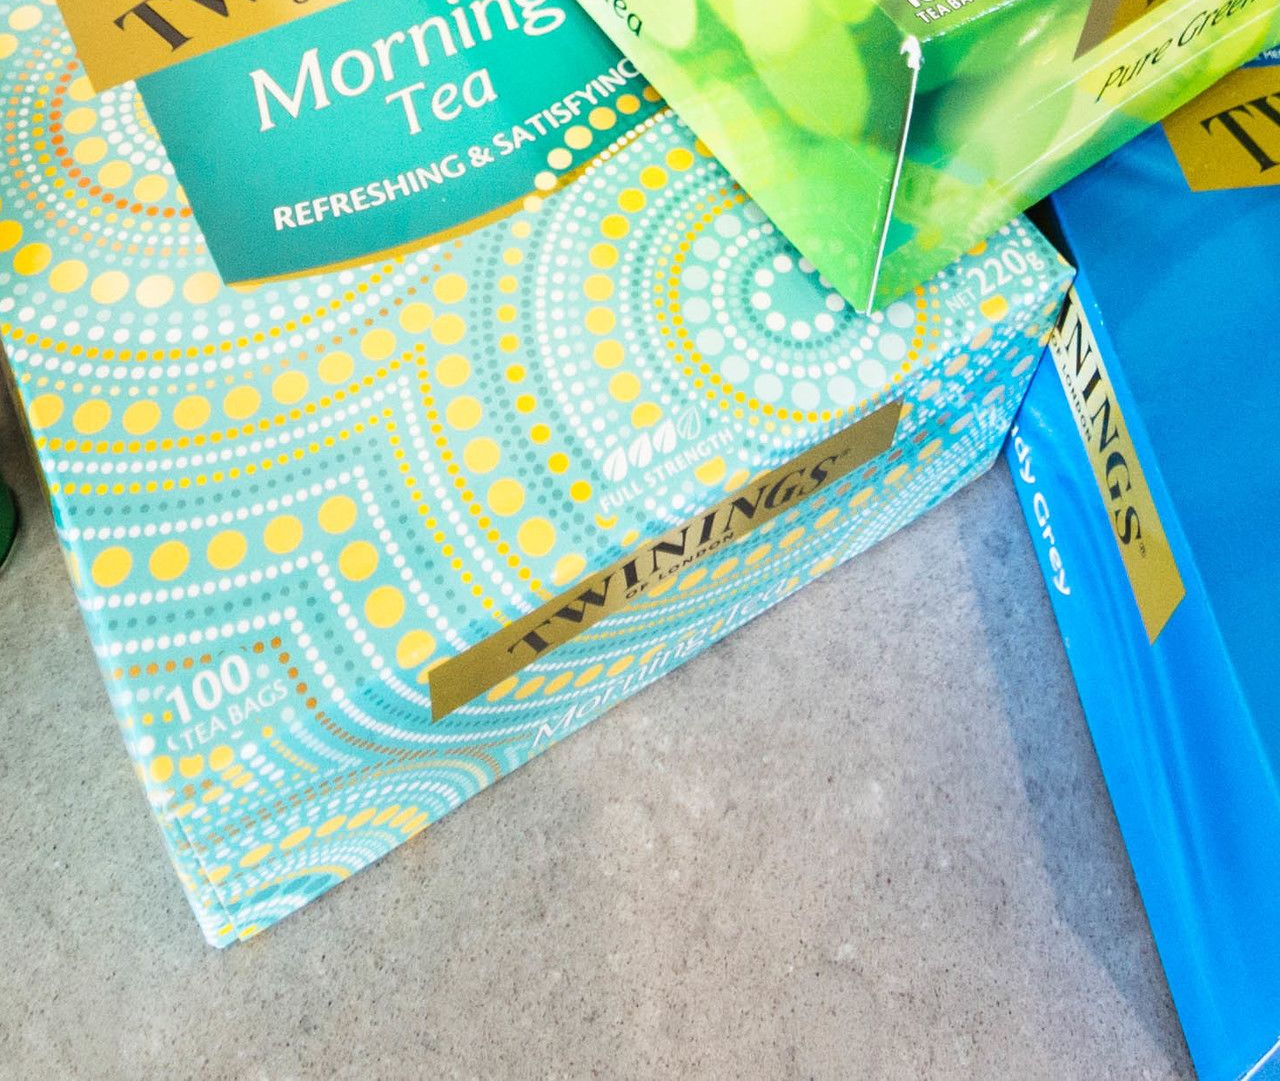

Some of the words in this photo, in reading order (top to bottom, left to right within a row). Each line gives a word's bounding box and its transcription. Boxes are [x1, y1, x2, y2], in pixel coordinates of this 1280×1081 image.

[915, 1, 952, 25] TEA
[384, 67, 499, 137] Tea
[1094, 36, 1174, 105] Pure
[272, 153, 468, 231] REFRESHING
[467, 143, 496, 170] &
[491, 56, 641, 157] SATISFYING
[965, 248, 1046, 298] 220g
[1055, 294, 1146, 547] ININGS
[1062, 364, 1093, 443] LONDON
[599, 480, 644, 514] FULL
[643, 427, 735, 489] STRENGTH
[1011, 424, 1036, 485] dy
[1032, 491, 1072, 597] Grey
[507, 453, 842, 657] TWININGS
[624, 581, 653, 601] OF
[656, 531, 736, 582] LONDON
[164, 653, 252, 725] 100
[178, 715, 228, 751] TEA
[226, 678, 289, 727] BAGS
[531, 627, 710, 749] Morning
